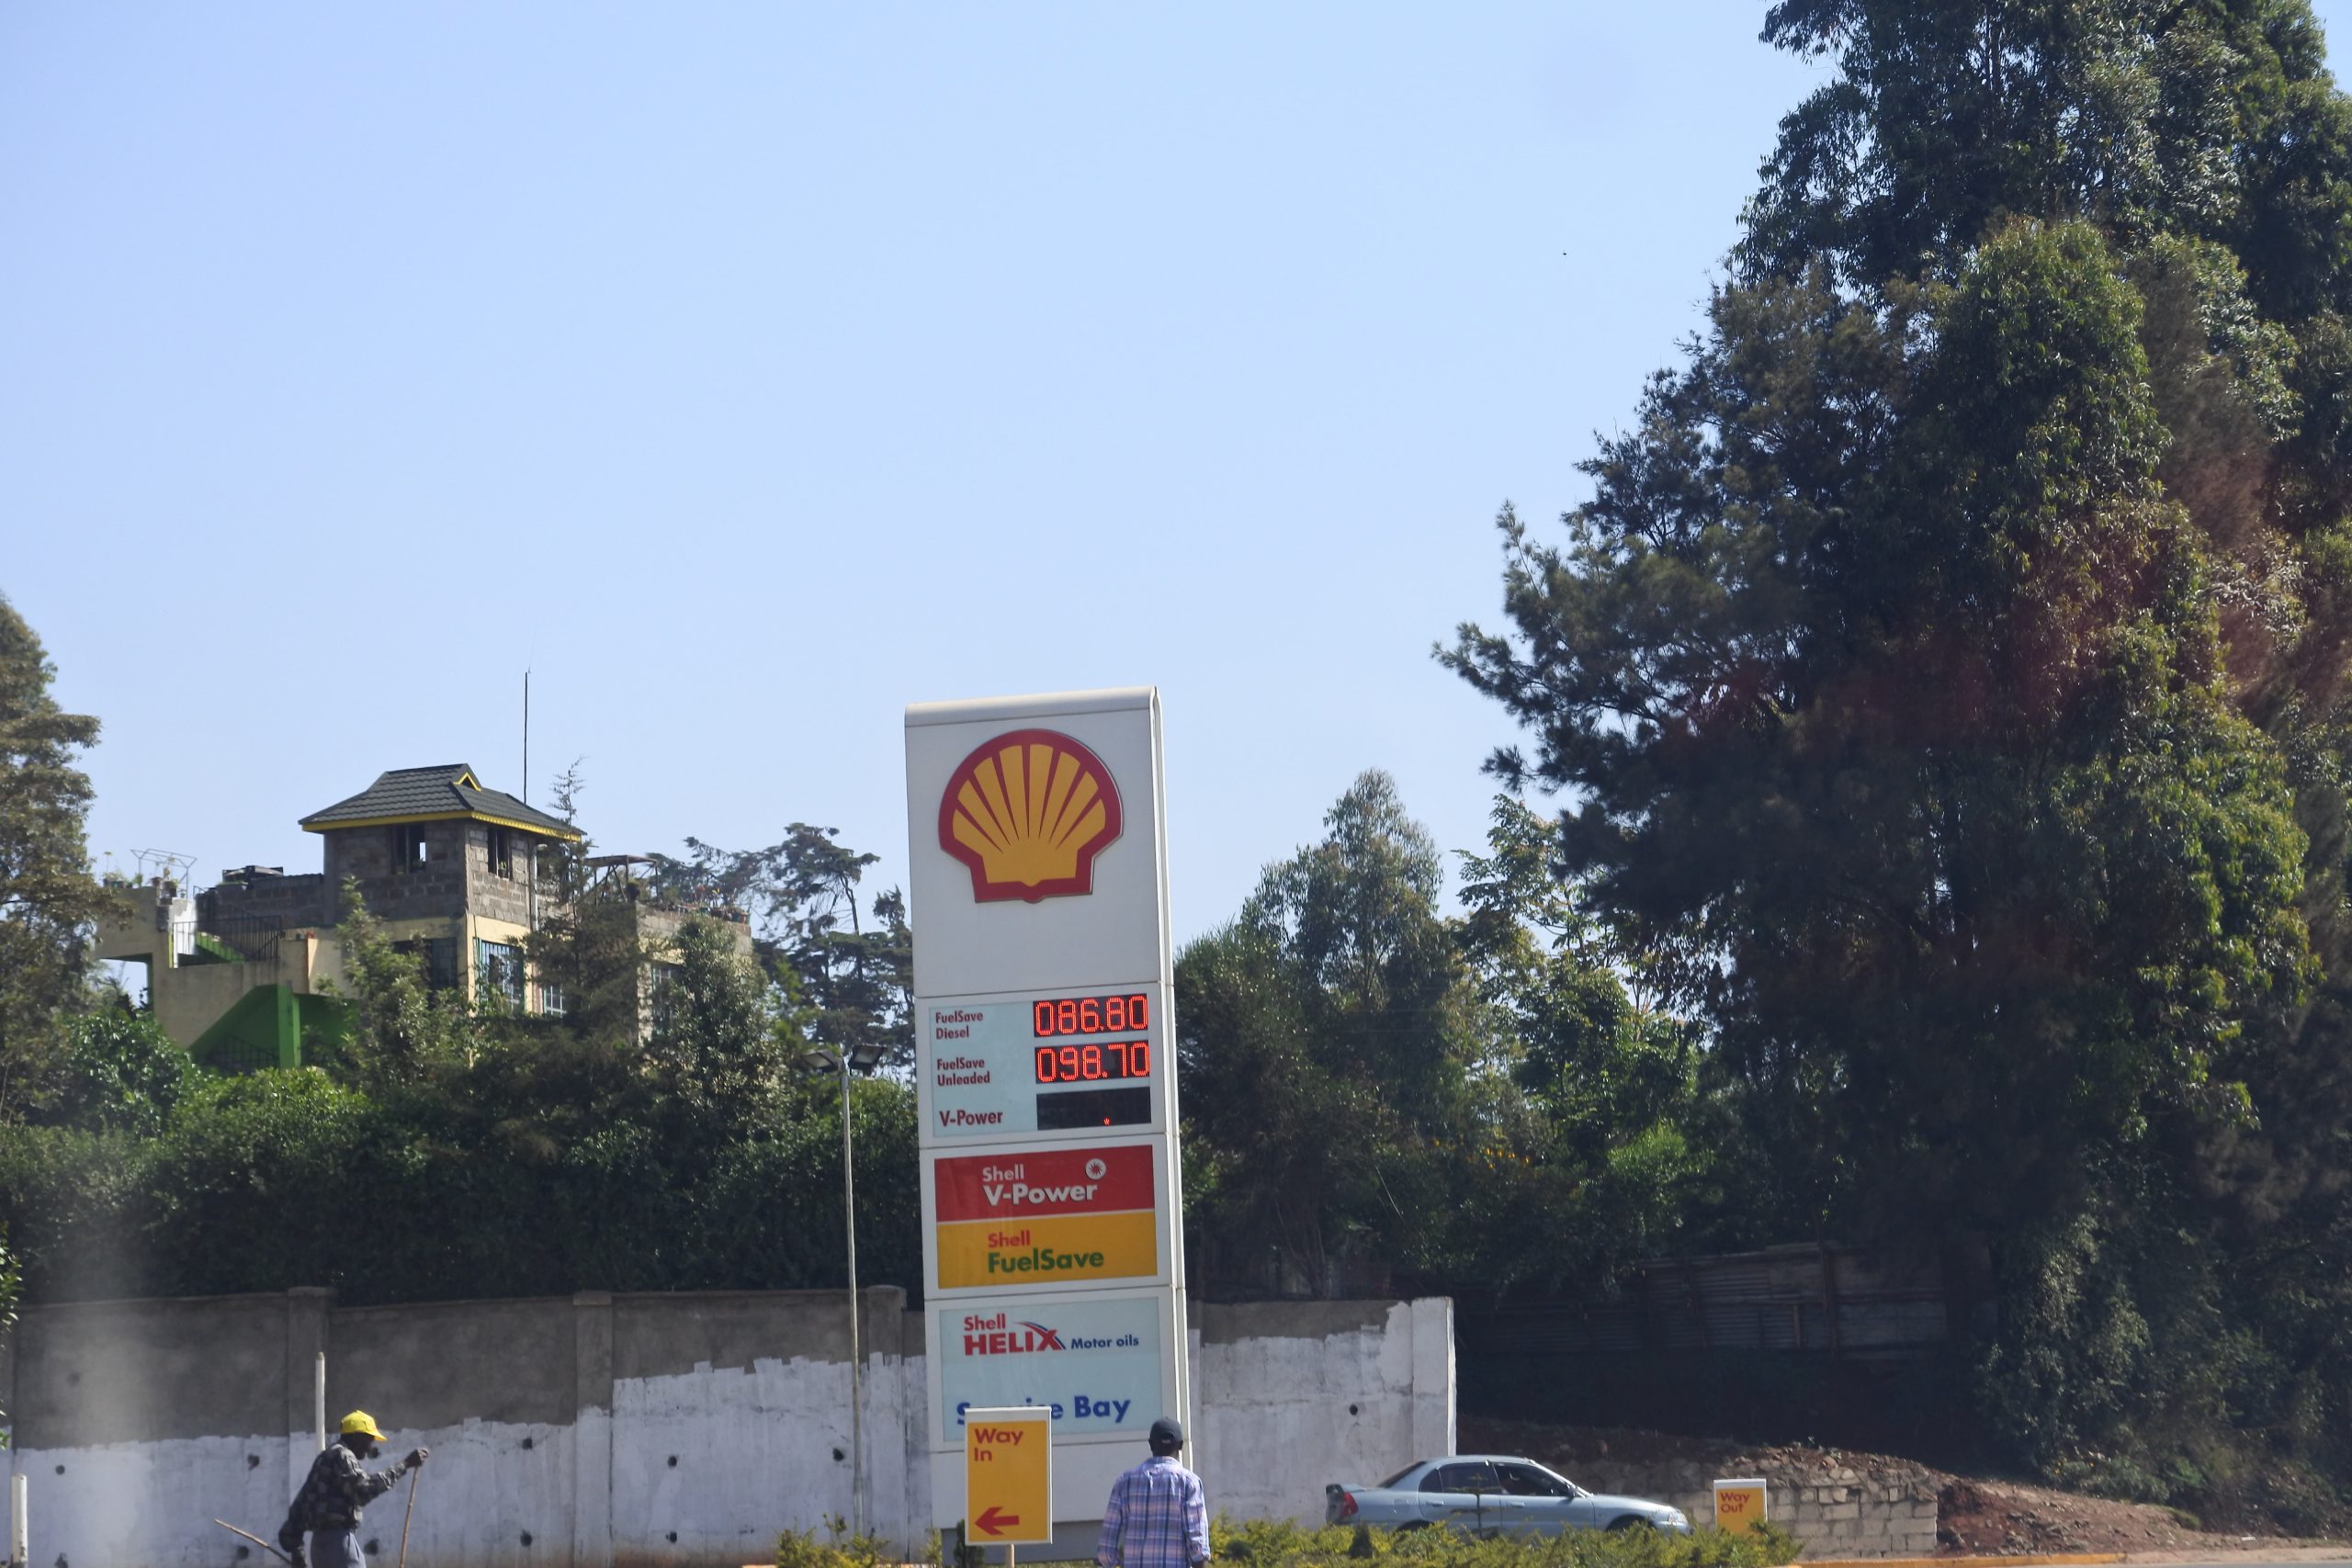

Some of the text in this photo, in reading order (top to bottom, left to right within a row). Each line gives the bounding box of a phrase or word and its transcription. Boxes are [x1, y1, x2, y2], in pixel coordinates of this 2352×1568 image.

[935, 1010, 983, 1024] FuelSave
[1035, 996, 1148, 1036] 086.80
[936, 1025, 970, 1039] Diesel
[937, 1057, 985, 1071] FuelSave
[1036, 1043, 1149, 1083] 098.70
[937, 1072, 990, 1087] Unleaded
[939, 1110, 1003, 1127] V-Power
[982, 1164, 1024, 1181] Shell
[983, 1183, 1098, 1205] V-Power
[988, 1230, 1031, 1247] Shell
[988, 1247, 1104, 1273] FuelSave
[964, 1314, 1006, 1331] Shell
[963, 1329, 1139, 1356] HELIX Motor oils
[1074, 1395, 1131, 1423] Bay
[974, 1428, 1023, 1446] Way
[974, 1447, 992, 1461] In
[1720, 1492, 1750, 1504] Way
[1721, 1503, 1744, 1513] Out
